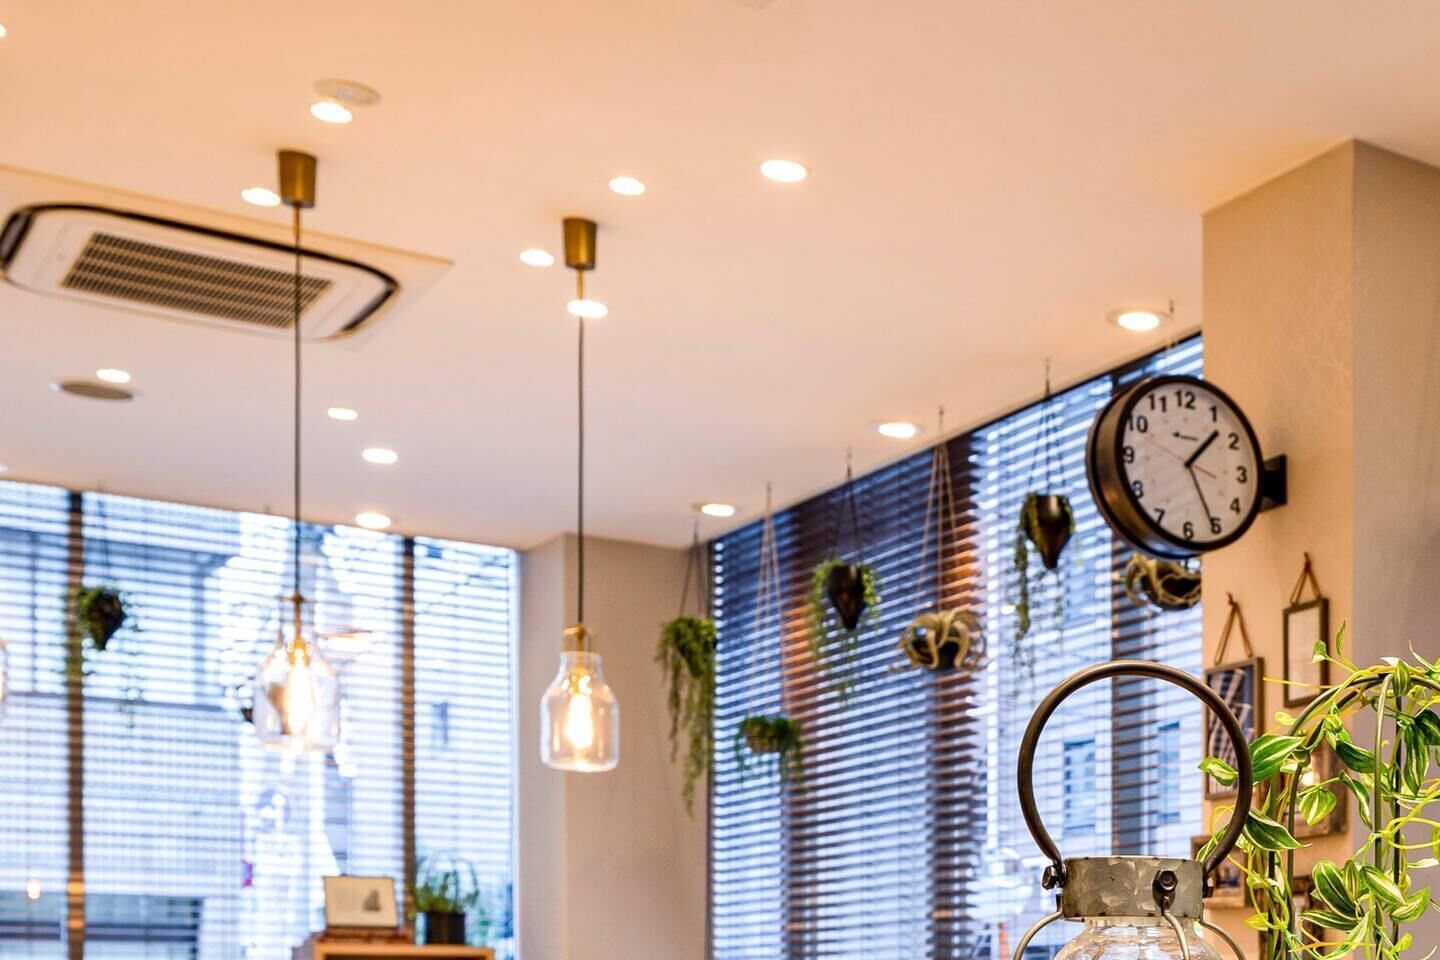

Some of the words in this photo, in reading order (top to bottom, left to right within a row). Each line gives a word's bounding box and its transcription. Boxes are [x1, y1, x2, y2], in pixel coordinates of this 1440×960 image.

[1148, 394, 1168, 413] 11
[1174, 389, 1197, 409] 12
[1208, 405, 1218, 423] 1
[1128, 414, 1148, 434] 10
[1228, 432, 1240, 450] 2
[1123, 446, 1135, 464] 9
[1236, 465, 1248, 484] 3
[1229, 497, 1241, 515] 4
[1154, 508, 1166, 526] 7
[1182, 521, 1194, 540] 6
